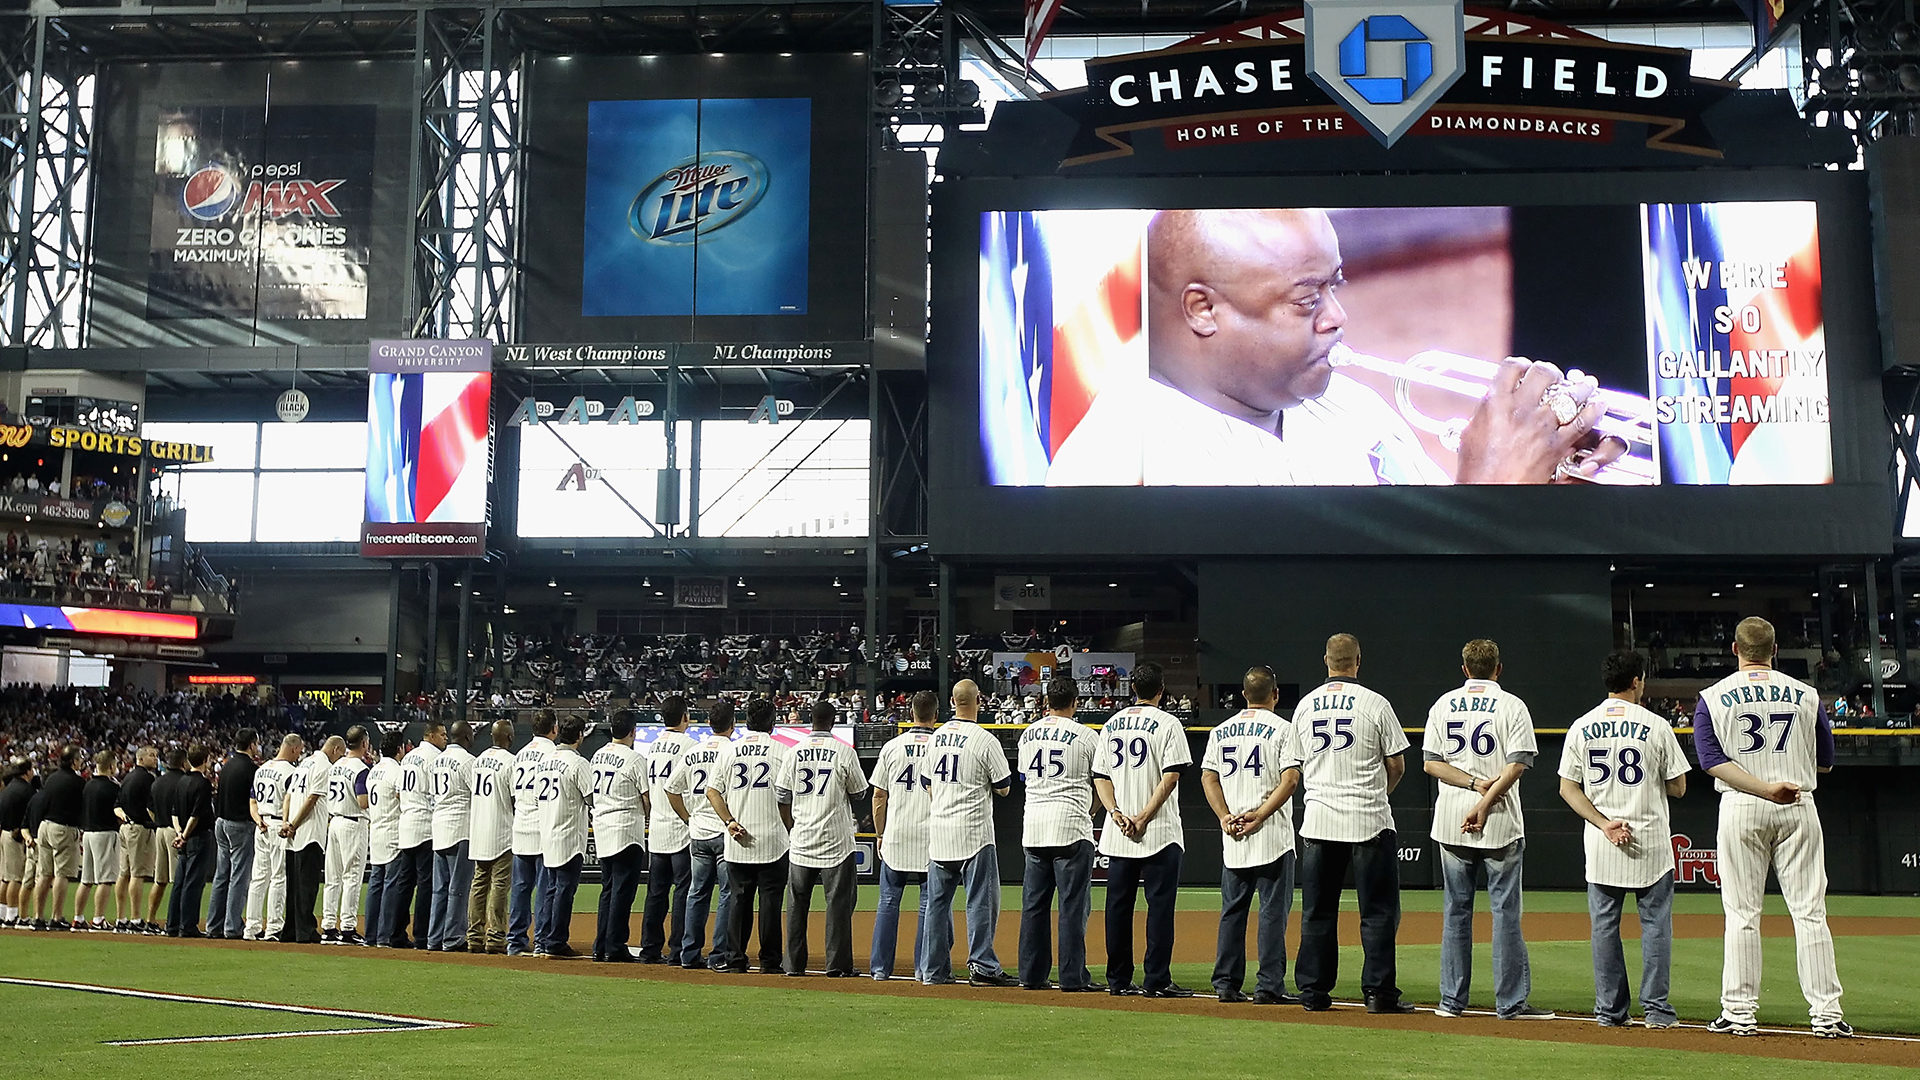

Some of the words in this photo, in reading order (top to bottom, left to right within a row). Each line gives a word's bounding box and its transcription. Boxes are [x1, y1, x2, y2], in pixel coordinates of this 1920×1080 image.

[1109, 58, 1293, 107] CHASE
[1482, 55, 1668, 99] FIELD
[1176, 123, 1239, 142] HOME
[1257, 119, 1284, 135] OF
[1302, 117, 1344, 132] THE
[1430, 116, 1601, 136] DIAMONDBACKS
[251, 162, 301, 179] pepsi
[665, 164, 731, 189] Miller
[240, 179, 347, 219] MAX
[650, 176, 748, 239] Lite
[176, 228, 235, 246] ZERO
[238, 228, 347, 246] CORIES
[173, 248, 250, 262] MAXIMUM
[378, 345, 425, 357] GRAND
[429, 344, 483, 357] CANYON
[505, 346, 529, 361] NL
[534, 346, 573, 361] West
[576, 345, 666, 364] Champions
[713, 345, 738, 360] NL
[741, 344, 832, 364] Champions
[398, 357, 463, 366] UNIVERSITY
[1657, 350, 1824, 379] GALLANTLY
[537, 403, 551, 414] 99
[588, 402, 600, 413] 01
[637, 402, 651, 413] 02
[778, 402, 790, 413] 01
[1656, 395, 1830, 424] STREAMING
[50, 427, 142, 456] SPORTS
[151, 440, 214, 463] GRILL
[585, 469, 598, 479] 07
[366, 532, 478, 545] freecreditscore.com
[1018, 585, 1046, 599] at&t
[910, 660, 932, 669] at&t
[1077, 681, 1096, 693] t&t
[1721, 684, 1806, 708] OVERBAY
[1313, 695, 1355, 712] ELLIS
[1450, 697, 1498, 713] SABEL
[1106, 716, 1159, 735] MOELLER
[1215, 722, 1276, 742] BROHAWN
[1311, 717, 1356, 753] 55
[1581, 721, 1651, 742] KOPLOVE
[1735, 711, 1798, 754] 37
[649, 742, 681, 755] URAZO
[935, 733, 969, 748] PRINZ
[1445, 719, 1498, 757] 56
[736, 745, 770, 757] LOPEZ
[796, 748, 837, 763] SPIVEY
[1110, 737, 1148, 769] 39
[1220, 744, 1265, 779] 54
[648, 760, 672, 784] 44
[934, 752, 961, 784] 41
[1028, 747, 1065, 778] 45
[1587, 746, 1645, 787] 58
[402, 769, 416, 792] 10
[433, 772, 449, 795] 13
[474, 773, 492, 797] 16
[515, 767, 535, 790] 22
[593, 770, 615, 795] 27
[733, 762, 771, 789] 32
[796, 767, 834, 796] 37
[256, 782, 275, 804] 82
[328, 781, 345, 802] 53
[370, 783, 378, 806] 6
[538, 777, 559, 801] 25
[1397, 848, 1421, 862] 407
[1901, 852, 1920, 868] 41
